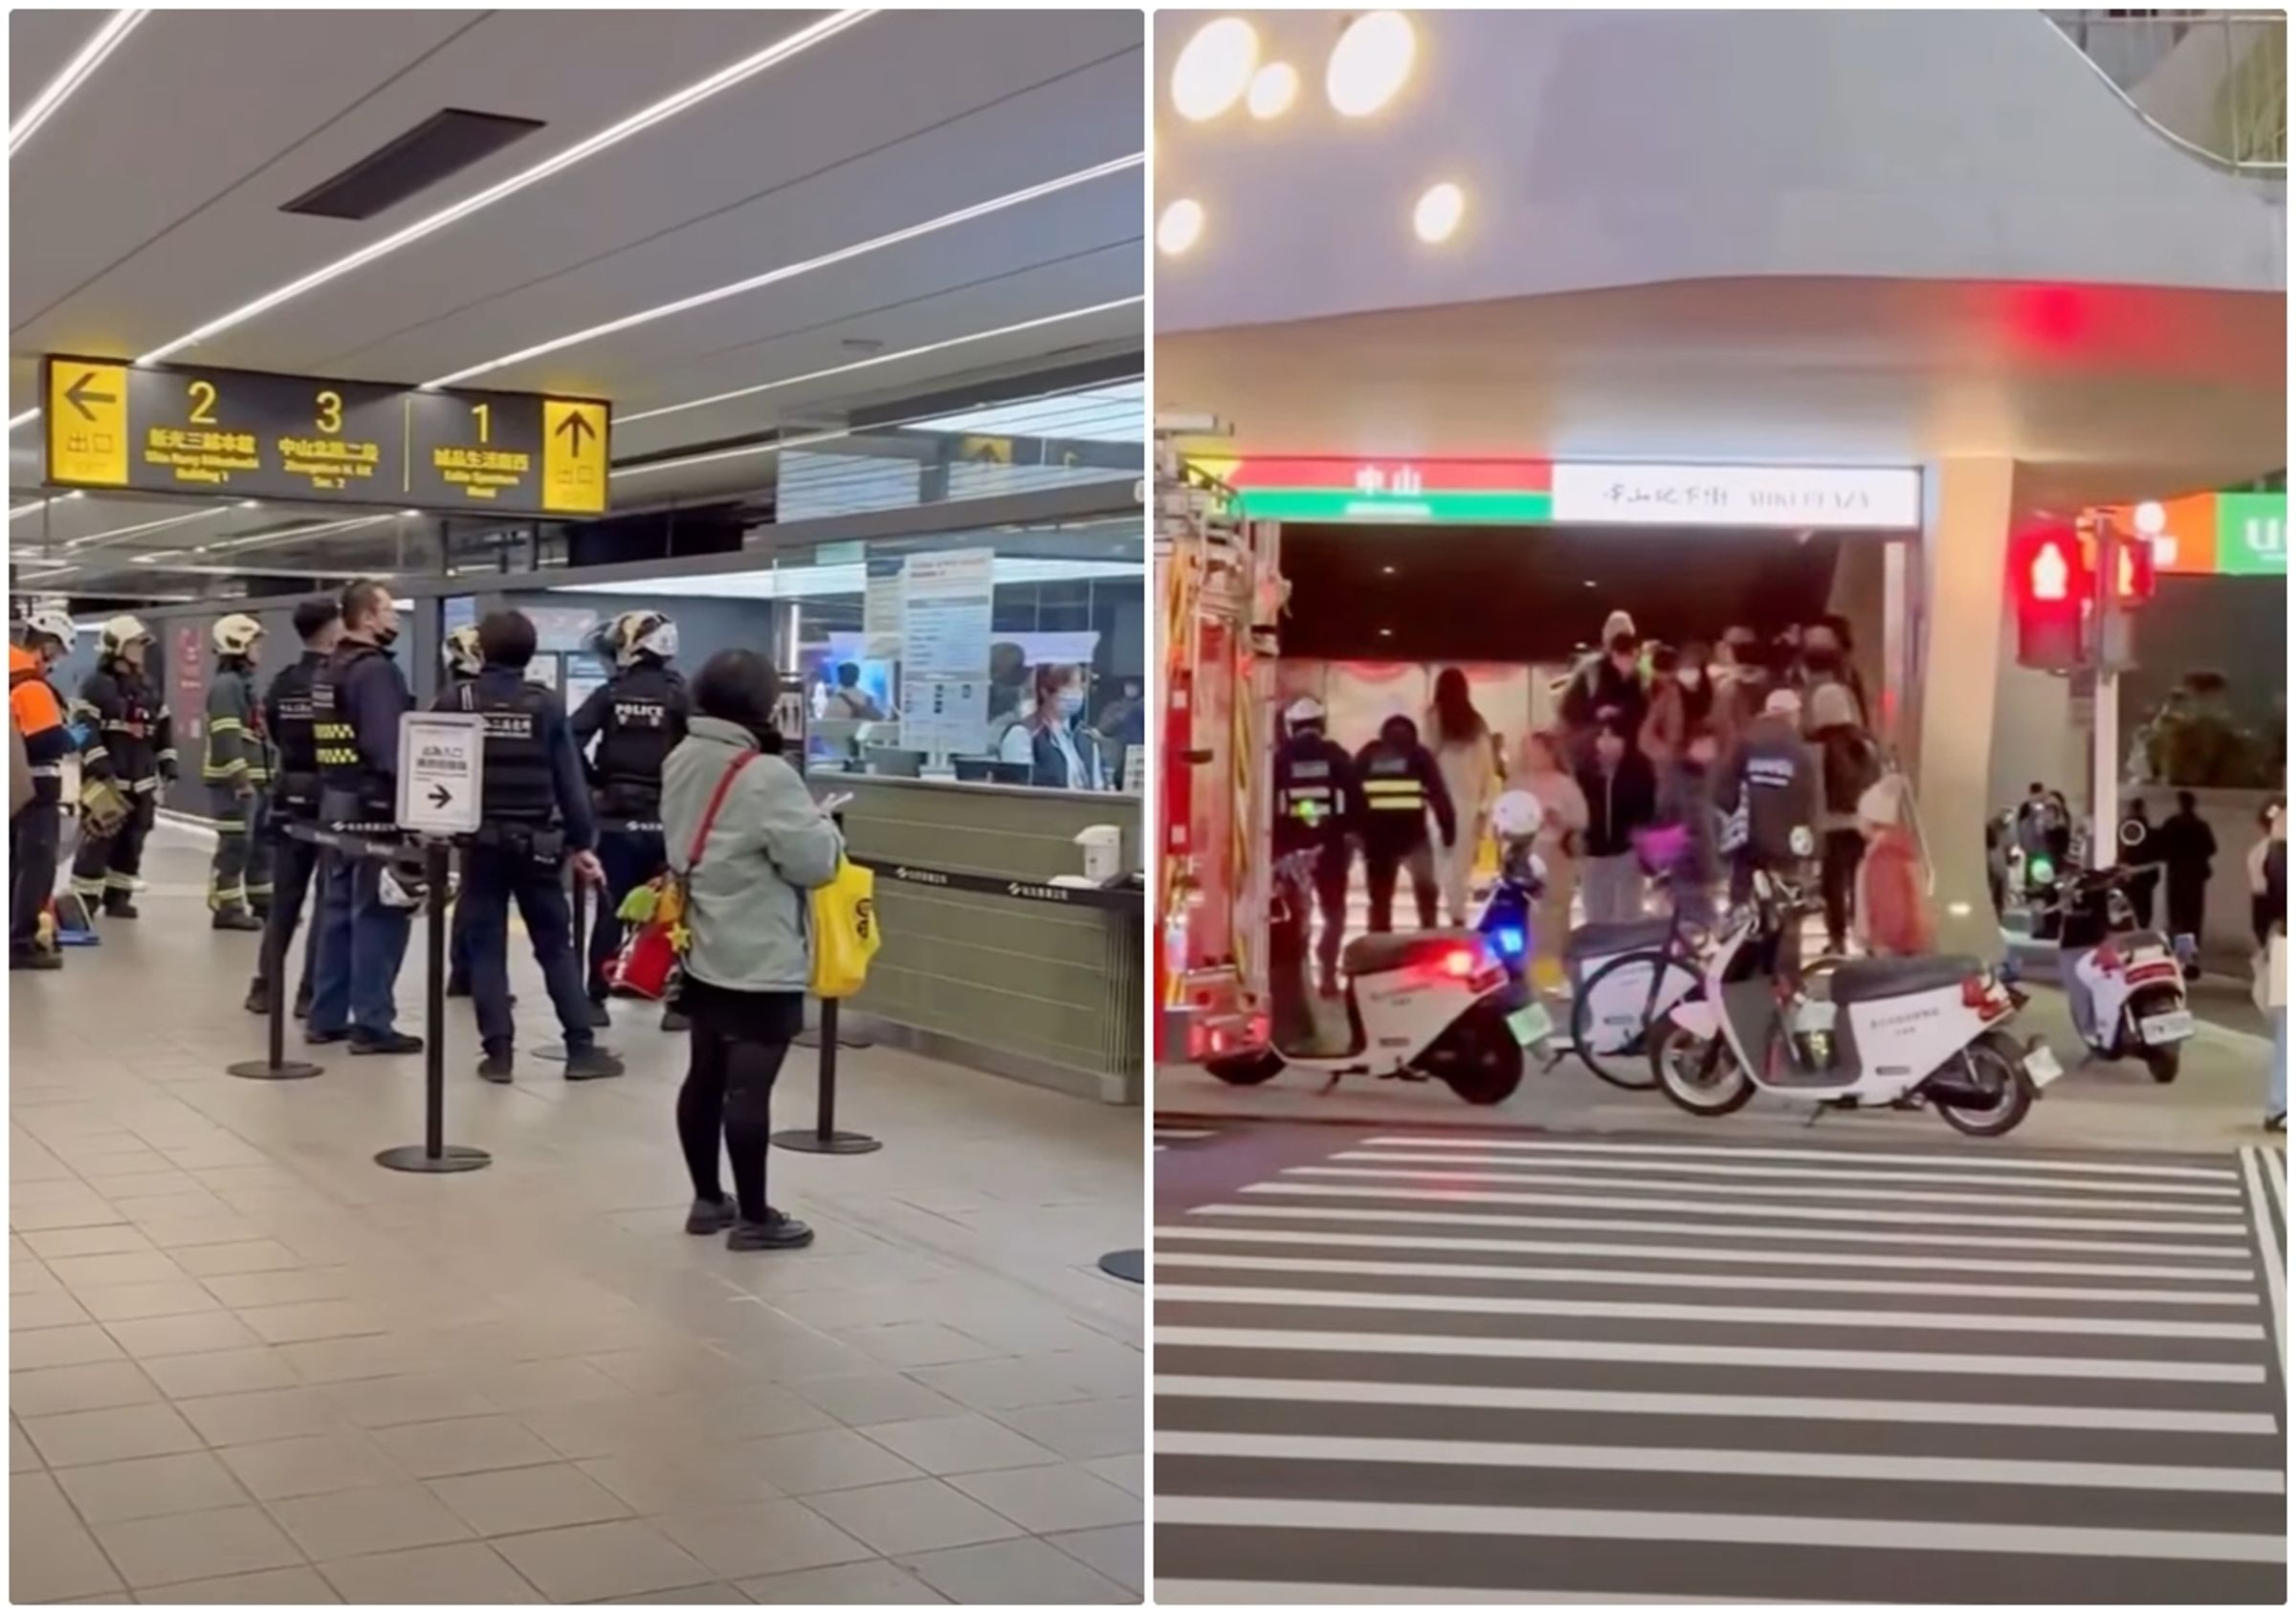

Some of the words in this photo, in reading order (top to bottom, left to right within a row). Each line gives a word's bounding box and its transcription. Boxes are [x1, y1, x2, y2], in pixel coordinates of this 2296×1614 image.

[188, 381, 217, 424] 2
[316, 390, 342, 432] 3
[472, 404, 489, 443] 1
[1355, 463, 1423, 497] 中山
[614, 702, 665, 718] POLICE
